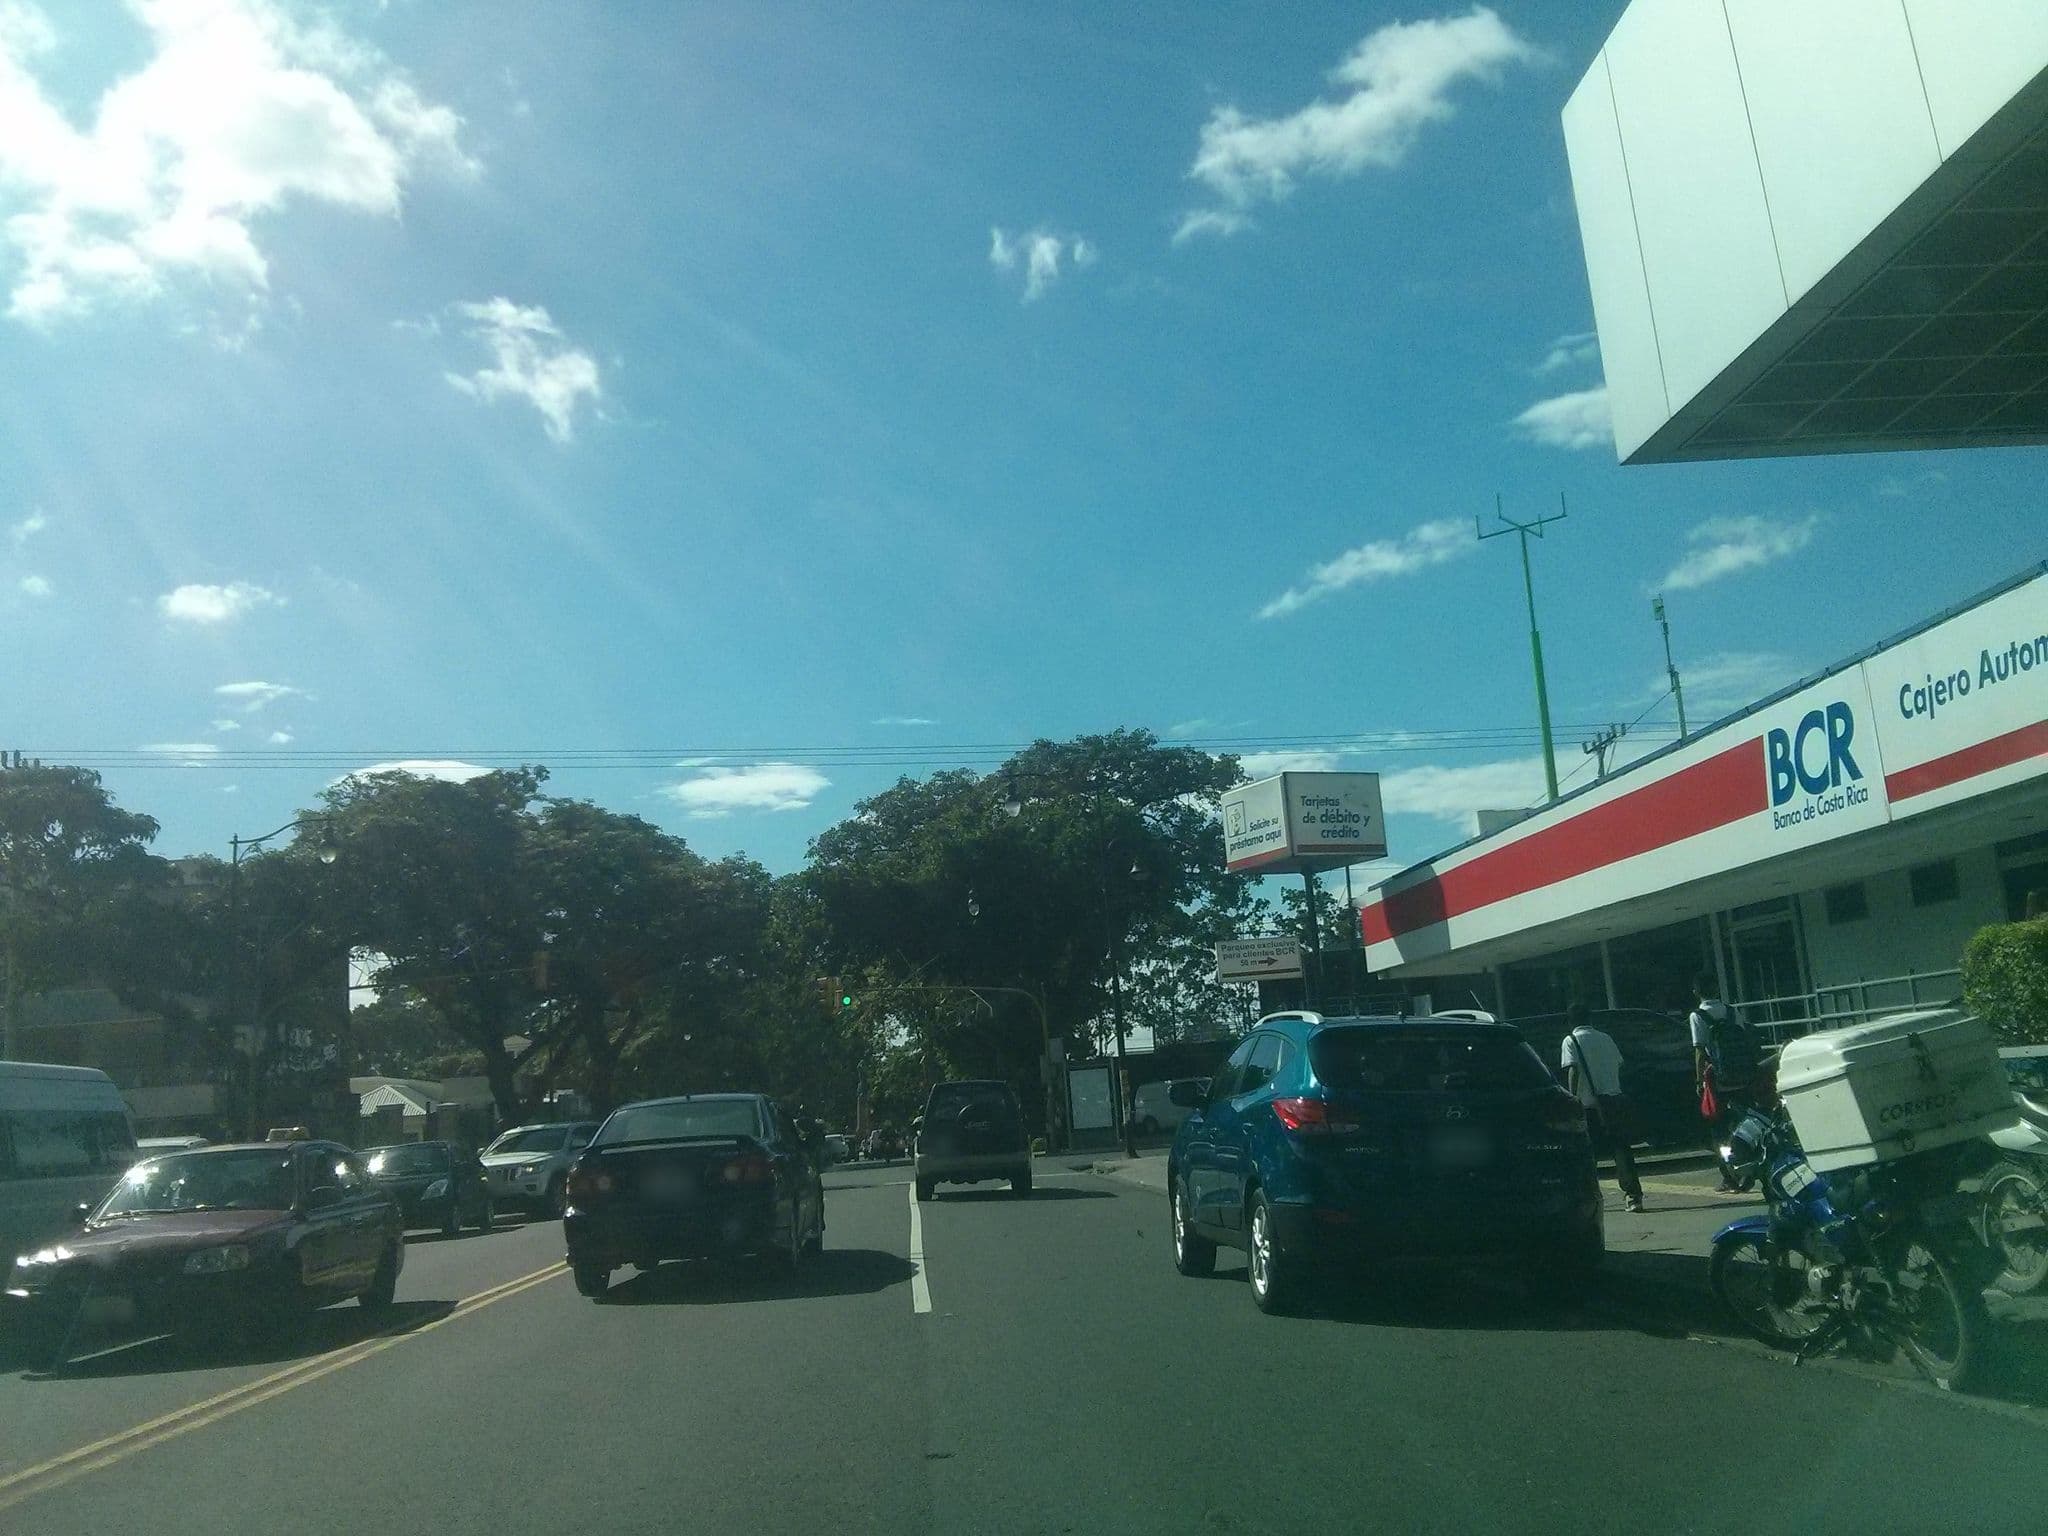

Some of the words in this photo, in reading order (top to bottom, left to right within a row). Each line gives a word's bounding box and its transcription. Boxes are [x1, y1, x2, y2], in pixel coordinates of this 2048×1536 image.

[1899, 668, 1971, 720] Cajero
[1768, 701, 1864, 807] BCR
[1300, 795, 1340, 809] Tarjetas
[1773, 807, 1801, 830] Banco
[1803, 801, 1816, 820] de
[1817, 791, 1845, 816] Costa
[1847, 785, 1868, 807] Rica
[1250, 819, 1270, 832] Solicite
[1271, 816, 1279, 825] su
[1303, 811, 1316, 824] de
[1320, 808, 1361, 824] débito
[1363, 815, 1371, 827] y
[1321, 824, 1360, 838] crédito
[1229, 833, 1264, 854] préstamo
[1265, 827, 1282, 842] aquí
[1221, 943, 1256, 952] Parqueo
[1257, 940, 1296, 948] exclusivo
[1223, 952, 1241, 960] para
[1242, 949, 1275, 958] clientes
[1275, 946, 1296, 956] BCR
